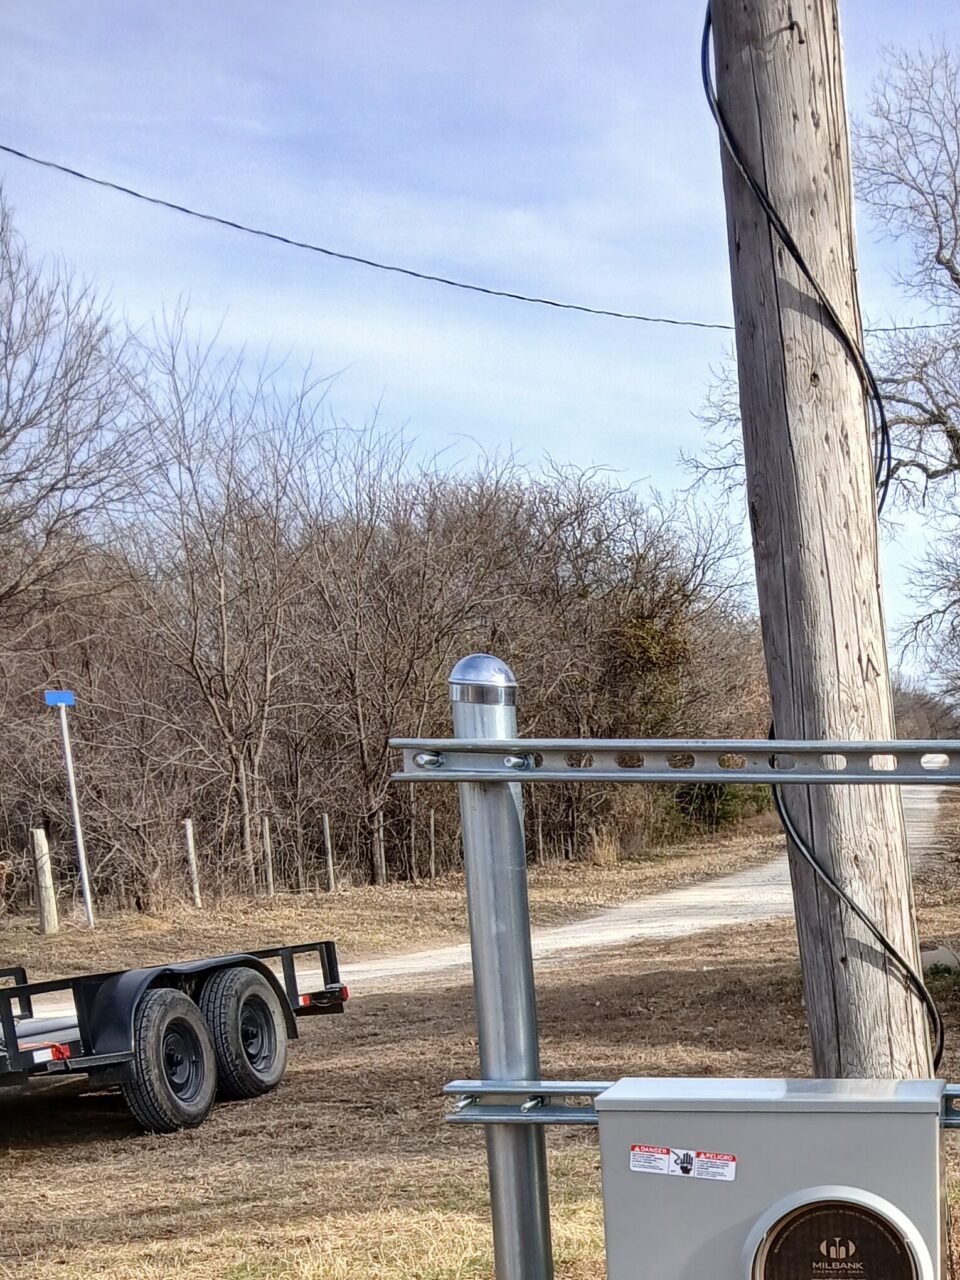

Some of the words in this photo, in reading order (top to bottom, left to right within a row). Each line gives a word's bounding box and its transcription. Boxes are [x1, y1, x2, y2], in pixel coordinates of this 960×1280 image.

[640, 1146, 668, 1154] DANGER
[705, 1153, 733, 1161] PELIGRO
[812, 1261, 864, 1270] MILBANK
